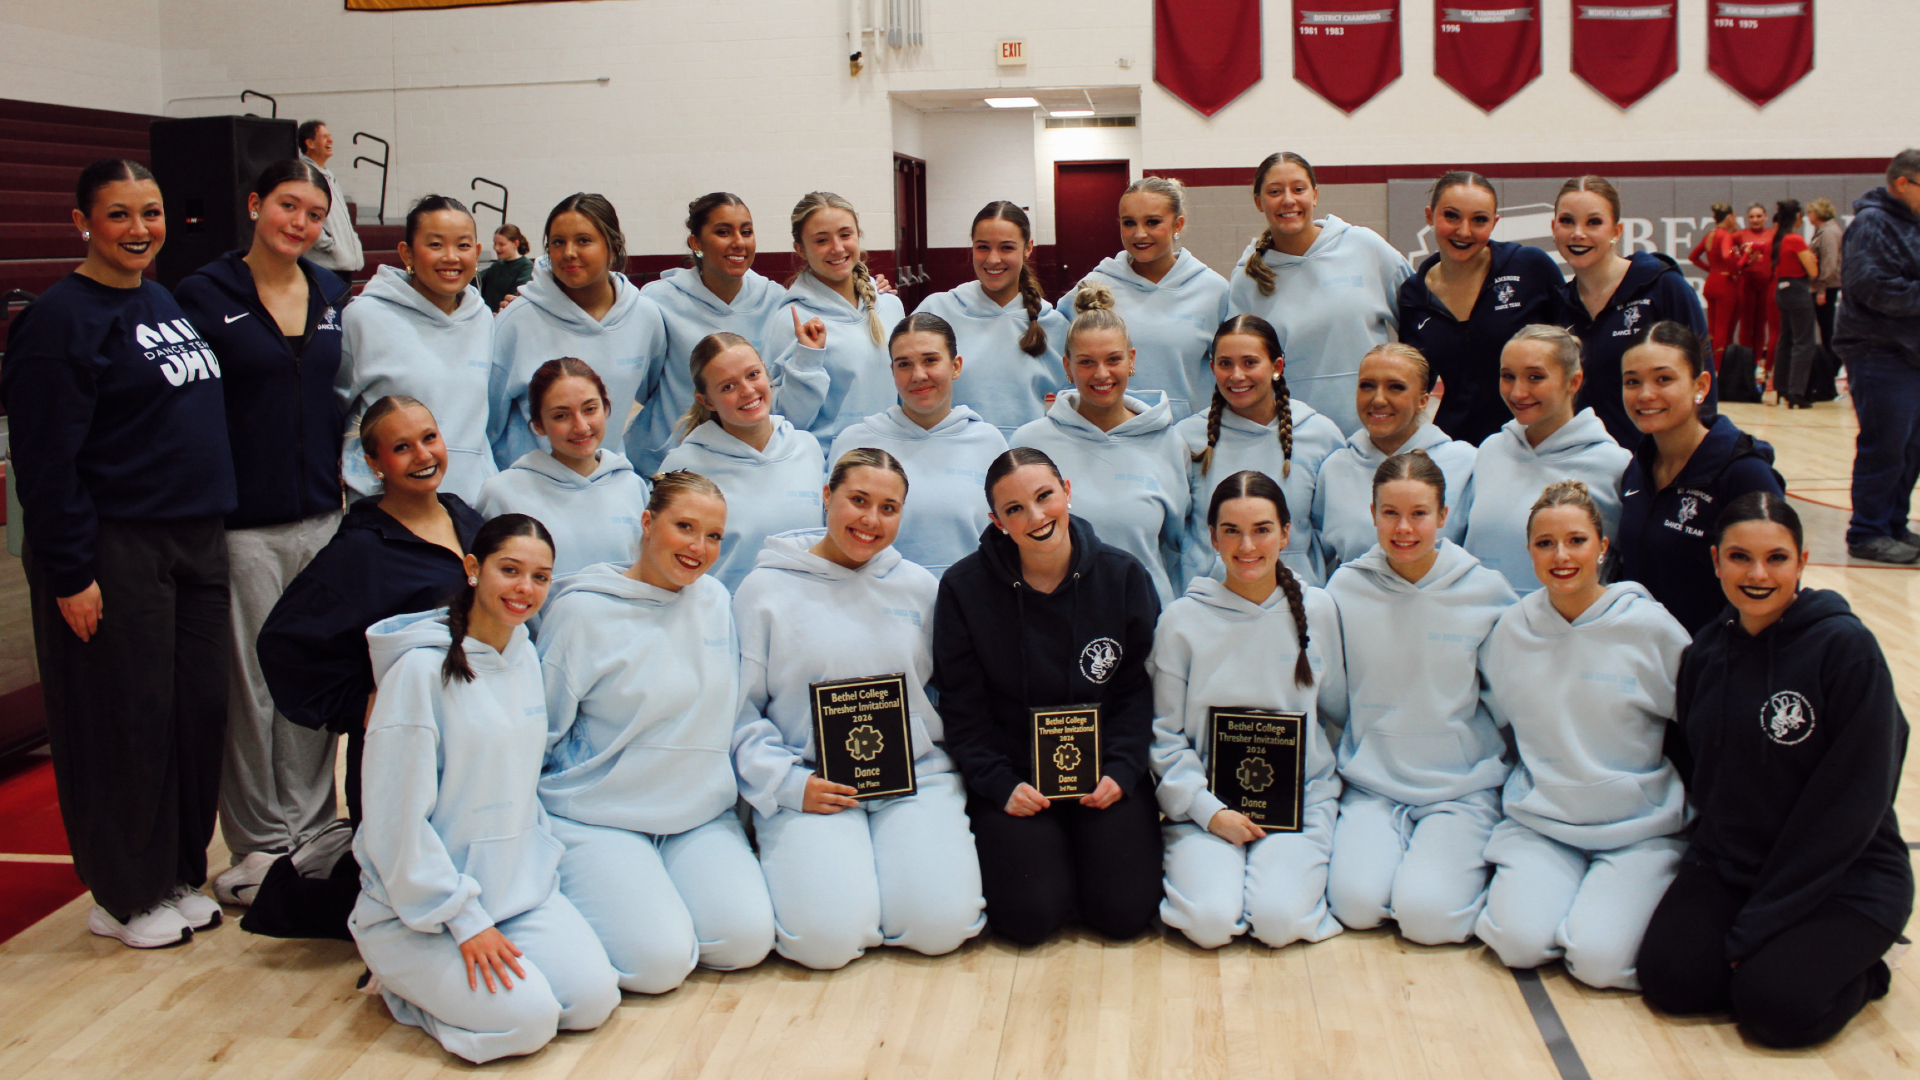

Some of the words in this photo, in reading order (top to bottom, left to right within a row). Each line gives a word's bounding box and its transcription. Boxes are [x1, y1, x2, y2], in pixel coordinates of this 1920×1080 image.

[1313, 14, 1342, 22] DISTRICT
[1342, 13, 1381, 22] CHAMPIONS
[1441, 24, 1460, 33] 1996
[1714, 18, 1734, 27] 1974
[1738, 19, 1758, 29] 1975
[1299, 26, 1318, 35] 1981
[1324, 27, 1344, 35] 1983
[1002, 42, 1022, 58] EXIT
[1612, 329, 1632, 337] DANCE
[143, 344, 188, 361] DANCE
[1664, 519, 1684, 531] DANCE
[1685, 525, 1705, 537] TEAM
[831, 691, 857, 703] Bethel
[858, 688, 889, 700] College
[822, 704, 857, 716] Thresher
[858, 698, 900, 712] Invitational
[852, 714, 873, 723] 2026
[1045, 717, 1064, 726] Bethel
[1065, 716, 1087, 726] College
[1038, 726, 1064, 735] Thresher
[1064, 724, 1095, 734] Invitational
[1228, 720, 1253, 731] Bethel
[1255, 722, 1286, 736] College
[1218, 732, 1252, 743] Thresher
[1253, 734, 1296, 746] Invitational
[1246, 746, 1266, 754] 2026
[854, 766, 880, 778] Dance
[1058, 775, 1077, 783] Dance
[1241, 796, 1267, 809] Dance
[1250, 811, 1265, 820] Place
